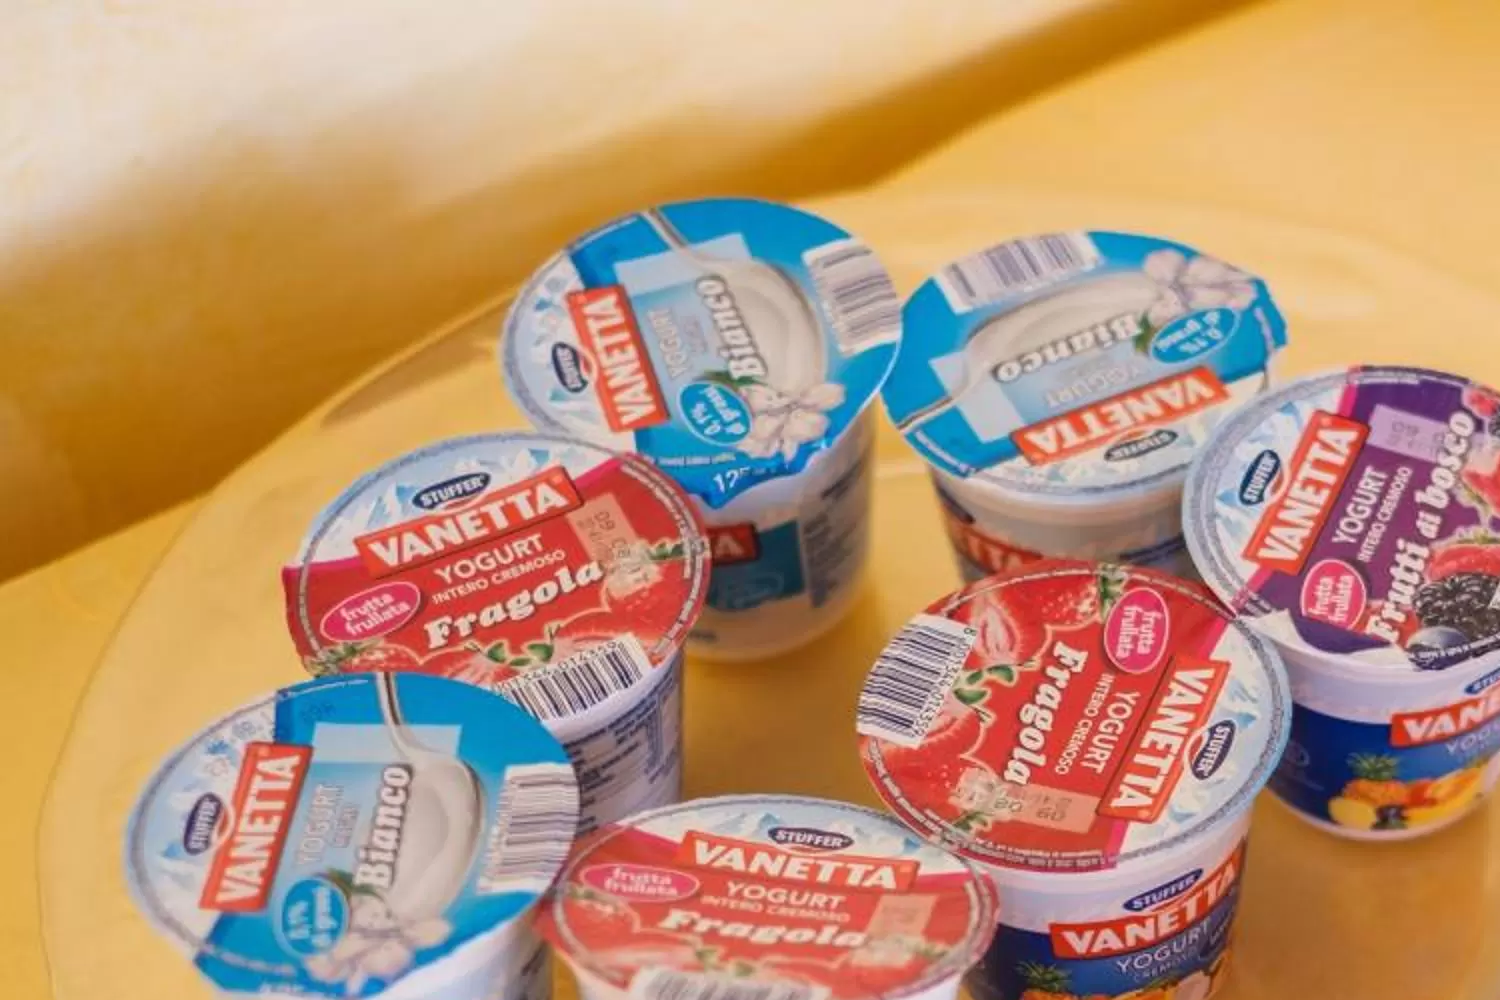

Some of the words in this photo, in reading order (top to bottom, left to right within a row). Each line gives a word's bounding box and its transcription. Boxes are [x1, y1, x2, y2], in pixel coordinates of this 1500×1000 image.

[647, 306, 689, 380] YOGURT
[697, 273, 768, 380] Bianco
[994, 313, 1141, 381] Bianco
[582, 293, 657, 425] VANETTA
[1026, 374, 1215, 455] VANETTA
[1245, 453, 1280, 503] STUFFER
[1416, 411, 1475, 510] bosco
[419, 474, 486, 507] STUFFER
[1258, 425, 1359, 564] VANETTA
[1331, 466, 1388, 545] YOGURT
[1358, 518, 1386, 563] INTERO
[1378, 466, 1413, 526] CREMOSO
[369, 481, 569, 567] VANETTA
[1416, 507, 1443, 540] di
[432, 577, 489, 605] INTERO
[491, 549, 566, 586] CREMOSO
[434, 532, 544, 585] YOGURT
[339, 592, 396, 622] frutta
[424, 560, 603, 649] Fragola
[1308, 575, 1332, 619] frutta
[1328, 574, 1355, 627] frullata
[1364, 539, 1429, 642] Frutti
[345, 601, 411, 639] frullata
[1117, 602, 1139, 660] frullata
[1138, 610, 1163, 656] frutta
[1004, 641, 1089, 786] Fragola
[1084, 673, 1116, 723] INTERO
[1056, 718, 1098, 776] CREMOSO
[1085, 690, 1141, 775] YOGURT
[1109, 666, 1214, 809] VANETTA
[1197, 723, 1233, 777] STUFFER
[216, 752, 300, 908] VANETTA
[296, 782, 345, 866] YOGURT
[354, 764, 413, 891] Bianco
[775, 830, 844, 849] STUFFER
[604, 878, 679, 899] frullata
[611, 867, 674, 886] frutta
[691, 840, 898, 890] VANETTA
[1133, 875, 1196, 909] STUFFER
[727, 881, 846, 909] YOGURT
[1062, 863, 1237, 955] VANETTA
[658, 908, 867, 949] Fragola
[1116, 920, 1209, 974] YOGURT
